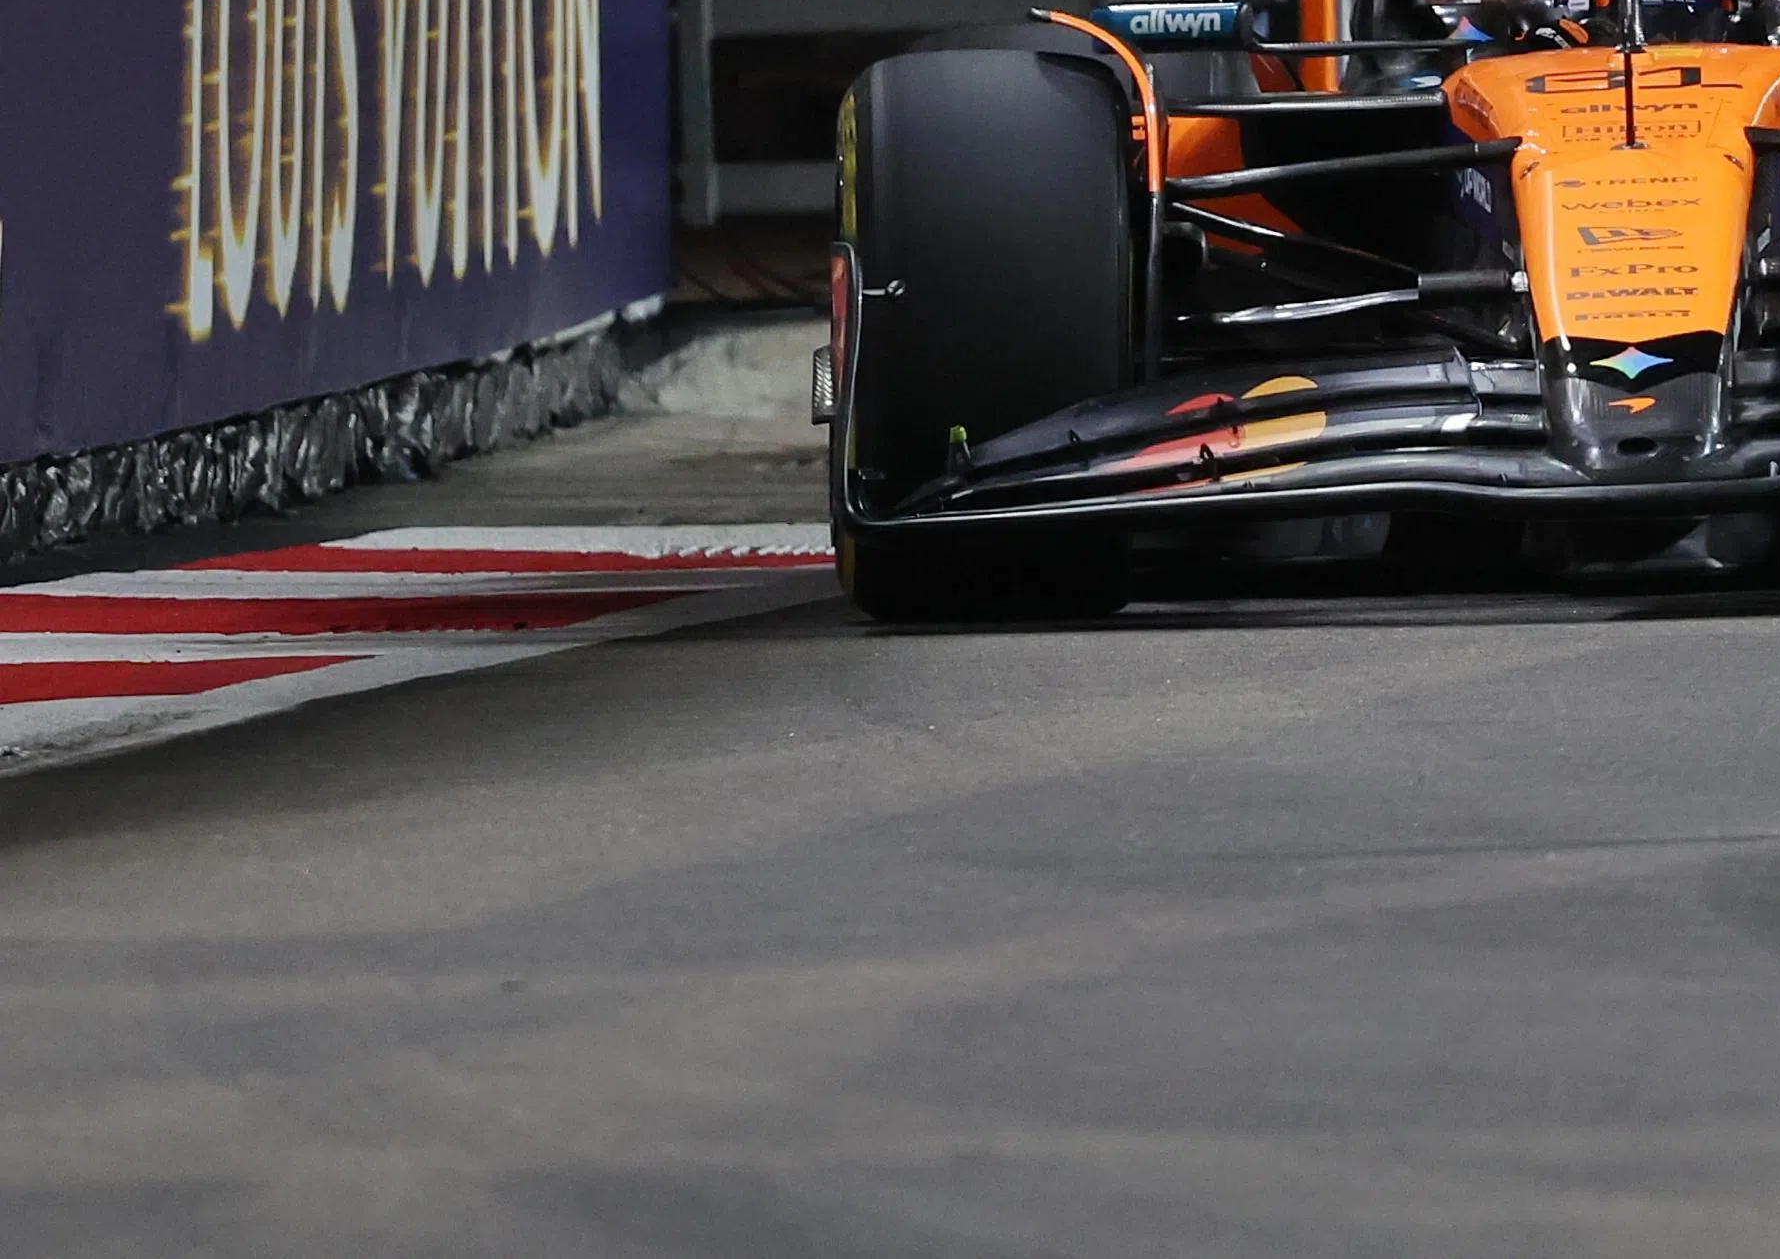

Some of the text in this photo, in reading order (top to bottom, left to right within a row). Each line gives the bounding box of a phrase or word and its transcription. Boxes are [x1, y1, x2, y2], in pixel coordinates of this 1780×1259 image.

[1129, 9, 1221, 38] allwyn
[1560, 102, 1699, 114] allwyn
[1575, 123, 1690, 135] Hilon
[1592, 175, 1690, 186] TREND
[1561, 198, 1702, 211] webex
[1569, 263, 1699, 278] FxPro
